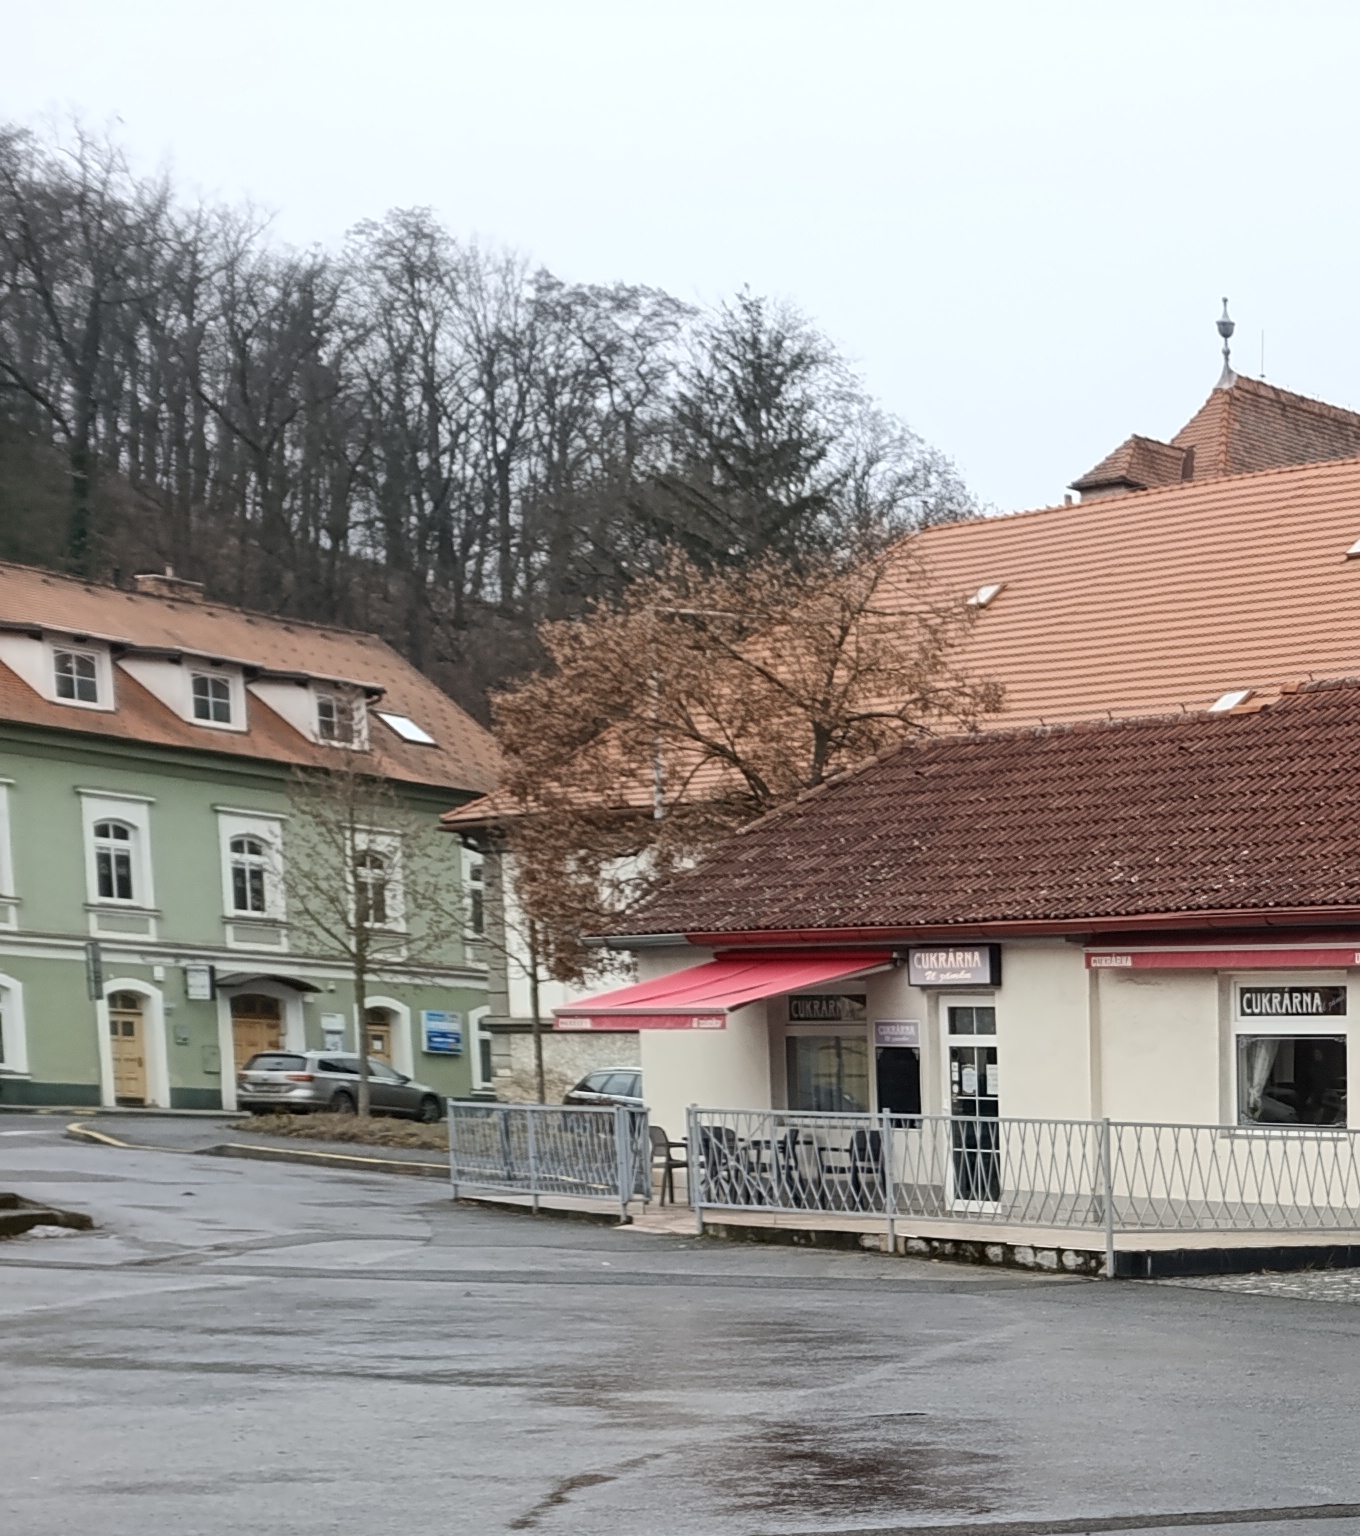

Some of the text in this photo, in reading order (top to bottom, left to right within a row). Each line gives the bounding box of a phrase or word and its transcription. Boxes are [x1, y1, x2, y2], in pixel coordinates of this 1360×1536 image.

[914, 948, 981, 969] CUKRÁRNA
[1090, 953, 1132, 966] CUKRÁRNA
[1243, 988, 1324, 1014] CUKRÁRNA
